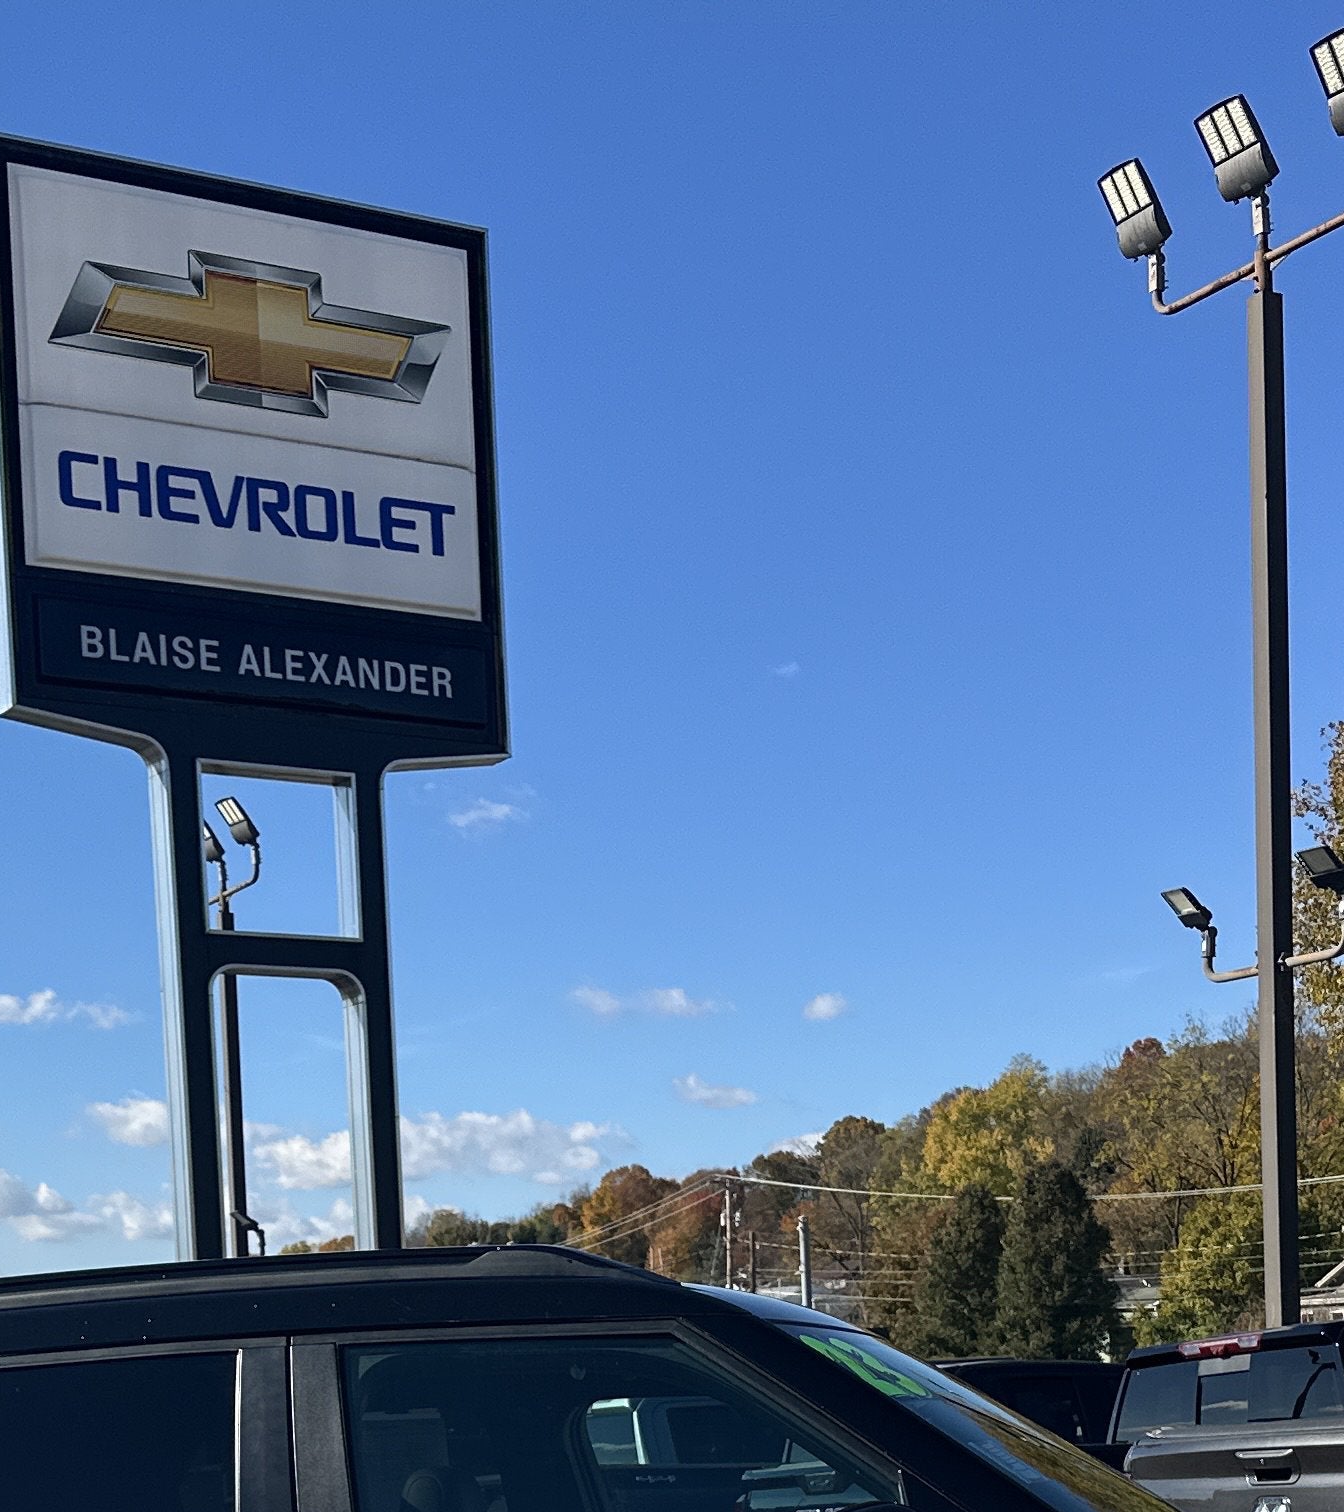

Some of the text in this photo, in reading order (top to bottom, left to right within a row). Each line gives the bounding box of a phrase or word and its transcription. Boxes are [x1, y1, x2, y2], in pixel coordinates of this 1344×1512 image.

[57, 448, 456, 557] CHEVROLET
[80, 624, 454, 698] BLAISE ALEXANDER
